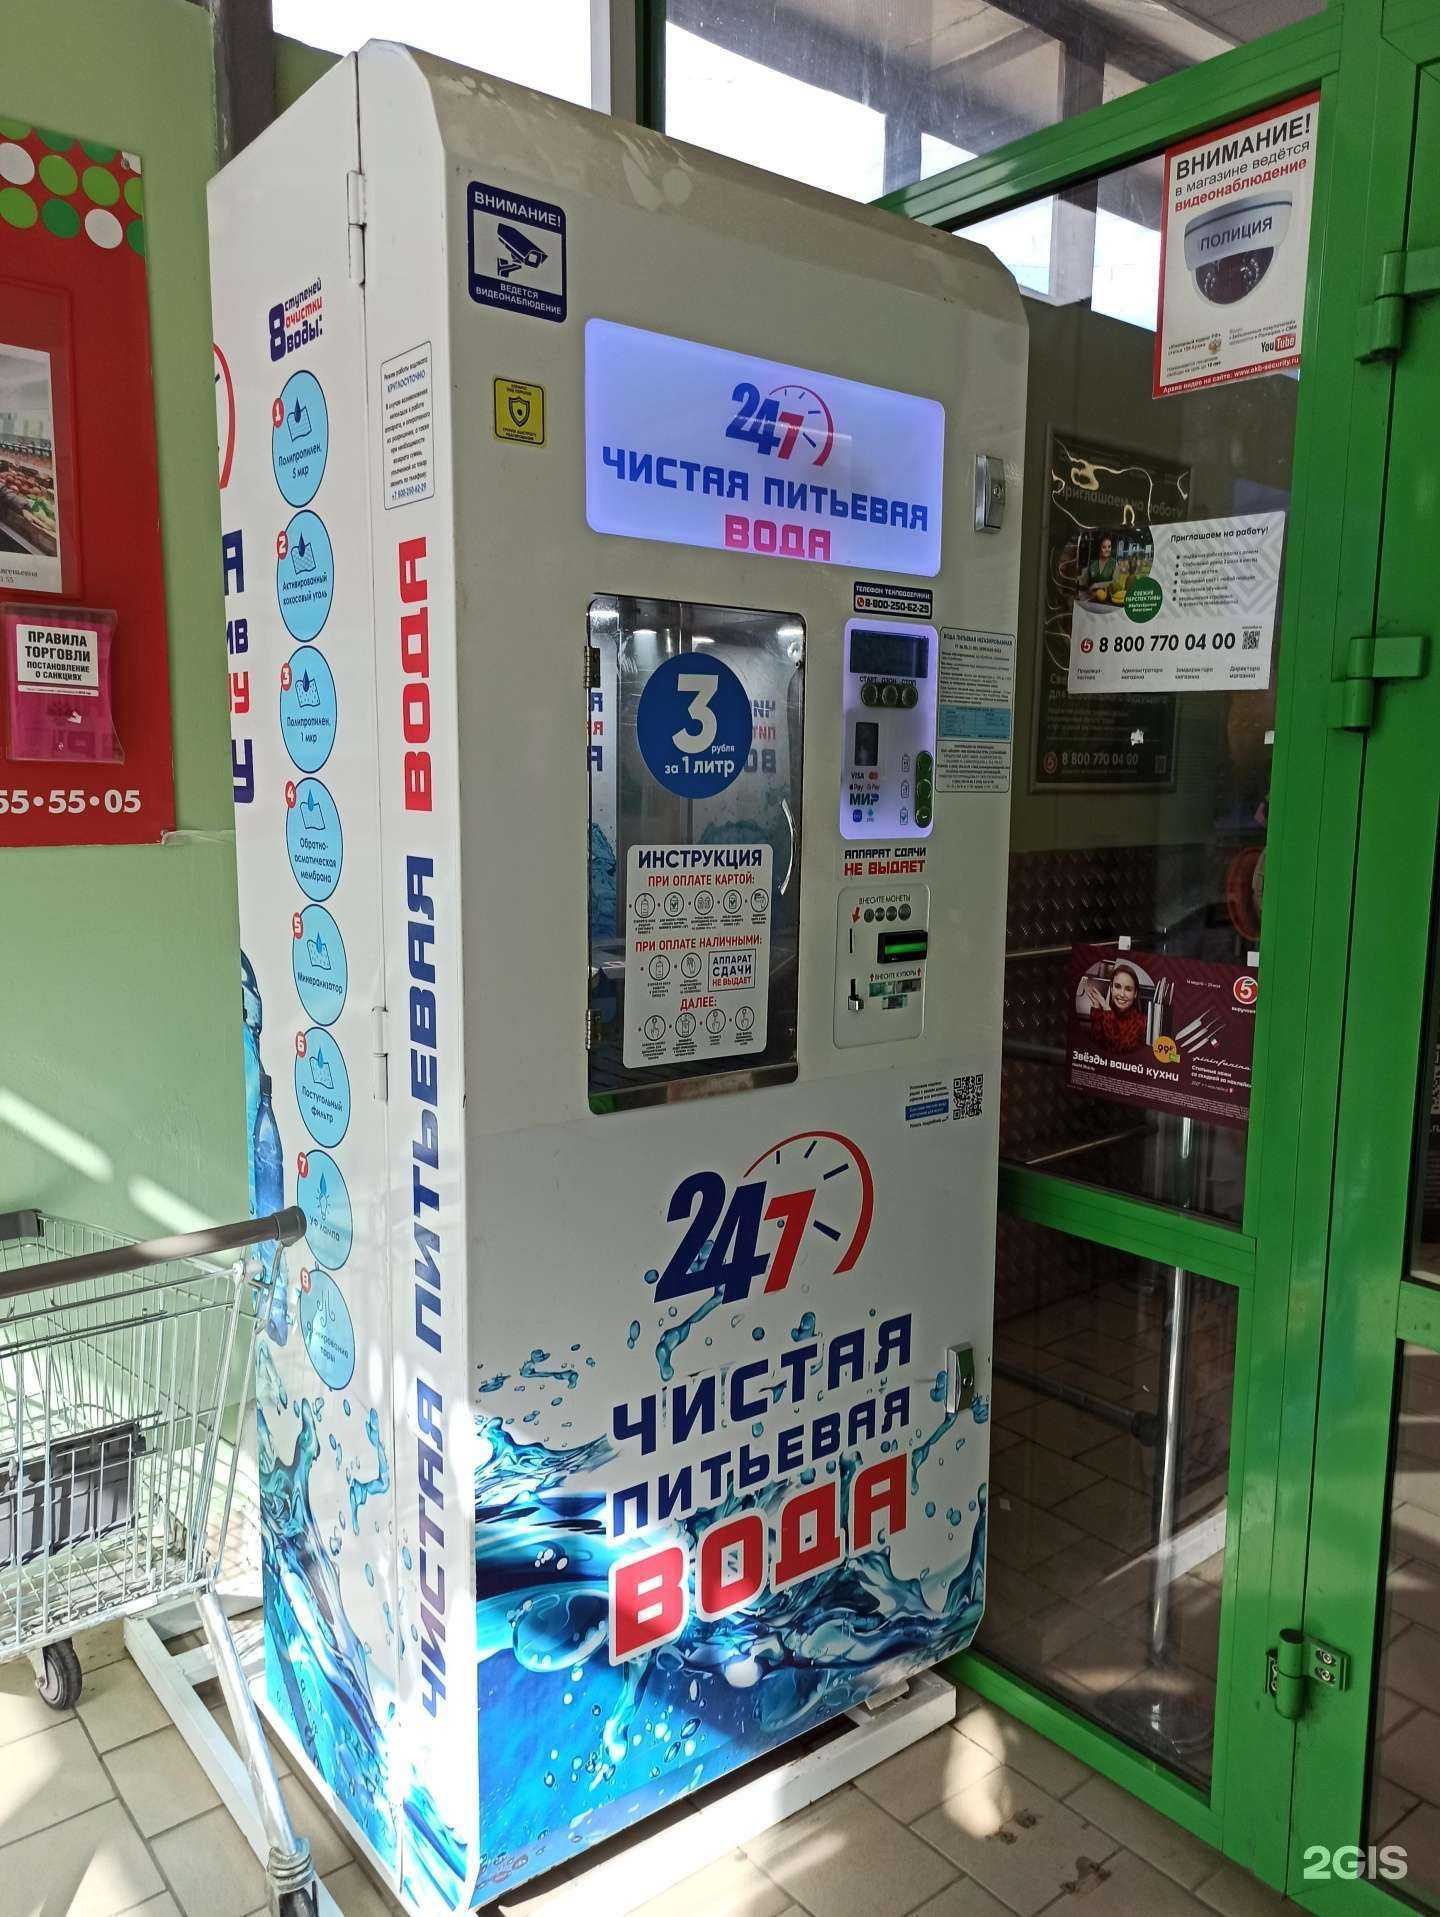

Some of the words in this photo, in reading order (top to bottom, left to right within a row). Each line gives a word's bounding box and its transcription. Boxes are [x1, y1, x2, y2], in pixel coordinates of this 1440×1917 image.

[1176, 113, 1311, 180] ВНИМАНИЕ!
[1176, 186, 1182, 197] в
[1186, 164, 1248, 194] магазине
[1252, 140, 1310, 169] ведётся
[1175, 158, 1307, 212] видеонаблюдение
[474, 191, 561, 227] ВНИМАНИЕ!
[1200, 216, 1273, 251] ПОЛИЦИЯ
[285, 277, 321, 311] ступеней
[475, 286, 562, 315] ВИДЕОНАБЛЮДЕНИЕ
[500, 283, 539, 300] ВЕДЕТСЯ
[286, 297, 322, 328] очистки
[269, 302, 286, 361] 8
[287, 314, 322, 353] воды:
[602, 446, 749, 501] ЧИСТАЯ
[764, 476, 928, 532] ПИТЬЕВАЯ
[723, 514, 831, 561] ВОДА
[1170, 532, 1222, 543] Приглашаем
[1223, 530, 1234, 538] на
[1235, 526, 1269, 540] работу!
[278, 535, 286, 554] 2
[282, 572, 328, 591] Активированный
[28, 630, 88, 648] ПРАВИЛА
[1099, 637, 1108, 653] 8
[1114, 636, 1144, 652] 800
[1150, 634, 1178, 652] 770
[1185, 634, 1206, 650] 04
[1212, 632, 1236, 650] 00
[25, 645, 91, 662] ТОРГОВЛИ
[26, 661, 90, 673] ПОСТАНОВЛЕНИЕ
[35, 670, 41, 678] О
[43, 671, 82, 682] САНКЦИЯХ
[282, 667, 290, 686] 3
[399, 536, 434, 811] ВОДА
[672, 673, 719, 754] 3
[711, 744, 735, 755] рубля
[664, 762, 679, 774] за
[682, 756, 690, 773] 1
[694, 760, 734, 778] литр
[286, 786, 295, 803] 4
[850, 793, 880, 806] МИР
[299, 837, 328, 852] Обратно-
[844, 848, 892, 859] АППАРАТ
[894, 847, 926, 857] СДАЧИ
[294, 853, 336, 868] осмотическая
[638, 849, 762, 869] ИНСТРУКЦИЯ
[844, 862, 863, 876] НЕ
[868, 860, 926, 876] ВЫДАЕТ
[300, 869, 332, 884] мембрана
[648, 876, 669, 888] ПРИ
[672, 874, 712, 887] ОПЛАТЕ
[715, 871, 755, 885] КАРТОЙ:
[886, 893, 911, 902] МОНЕТЫ
[635, 940, 658, 953] ПРИ
[659, 938, 696, 950] ОПЛАТЕ
[700, 934, 762, 949] НАЛИЧНЫМИ:
[712, 954, 752, 965] АППАРАТ
[712, 964, 752, 976] СДАЧИ
[298, 970, 343, 994] Минерализатор
[712, 978, 722, 987] НЕ
[723, 976, 752, 986] ВЫДАЕТ
[680, 996, 717, 1012] ДАЛЕЕ:
[1072, 1050, 1108, 1067] Звёзды
[1110, 1060, 1144, 1074] вашей
[1146, 1067, 1179, 1082] кухни
[302, 1085, 342, 1112] Постугольный
[406, 855, 442, 1353] ПИТЬЕВАЯ
[310, 1106, 334, 1124] фильтр
[612, 1313, 913, 1456] ЧИСТАЯ
[612, 1386, 911, 1538] ПИТЬЕВАЯ
[416, 1376, 447, 1718] ЧИСТАЯ
[614, 1453, 908, 1657] ВОДА
